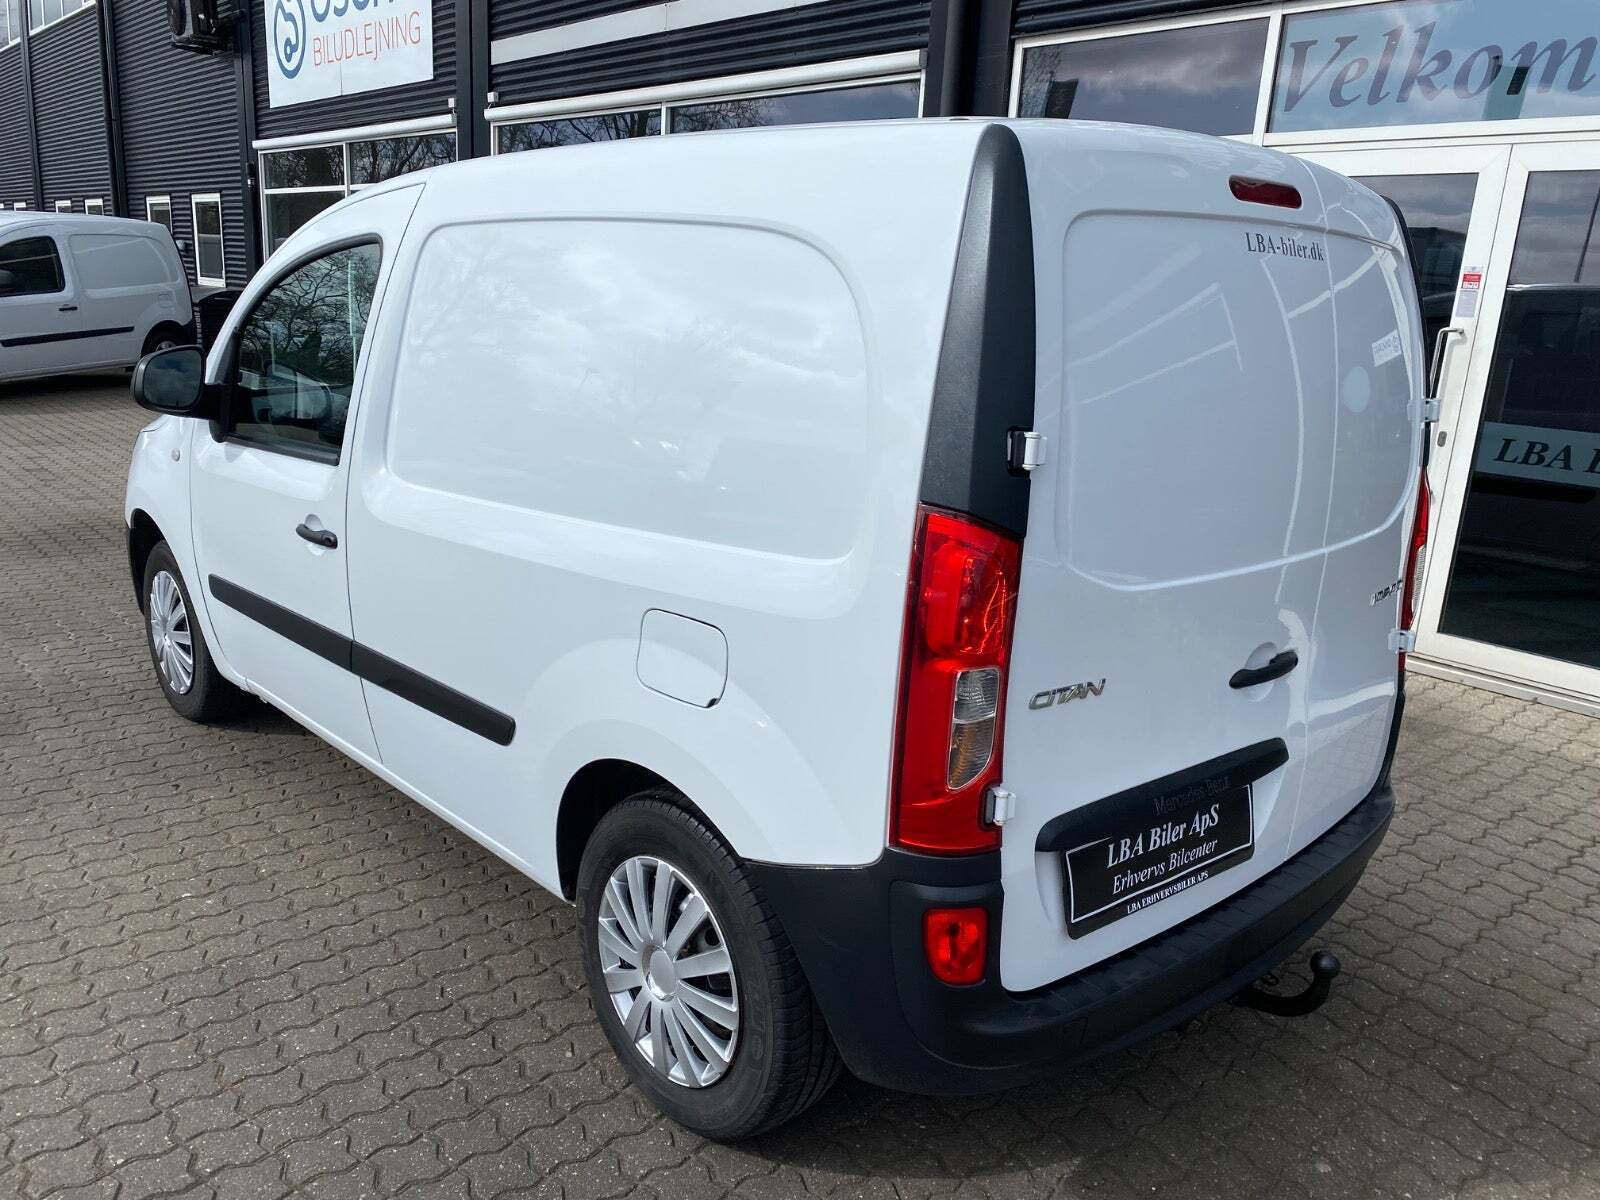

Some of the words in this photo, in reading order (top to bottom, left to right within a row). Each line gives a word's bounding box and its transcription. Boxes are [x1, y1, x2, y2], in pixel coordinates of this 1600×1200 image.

[313, 11, 421, 66] BILUDLEJNING
[1245, 232, 1324, 261] LBA-biler.dk
[1493, 438, 1573, 471] LBA
[1029, 678, 1106, 710] CITAN
[1107, 833, 1144, 868] LBA
[1149, 821, 1187, 852] Biler
[1189, 804, 1220, 836] ApS
[1112, 861, 1165, 895] Erhvervs
[1169, 839, 1218, 871] Bilcenter
[1127, 902, 1141, 914] LBA
[1142, 876, 1196, 906] ERHVERVSBILER
[1197, 871, 1209, 883] APS
